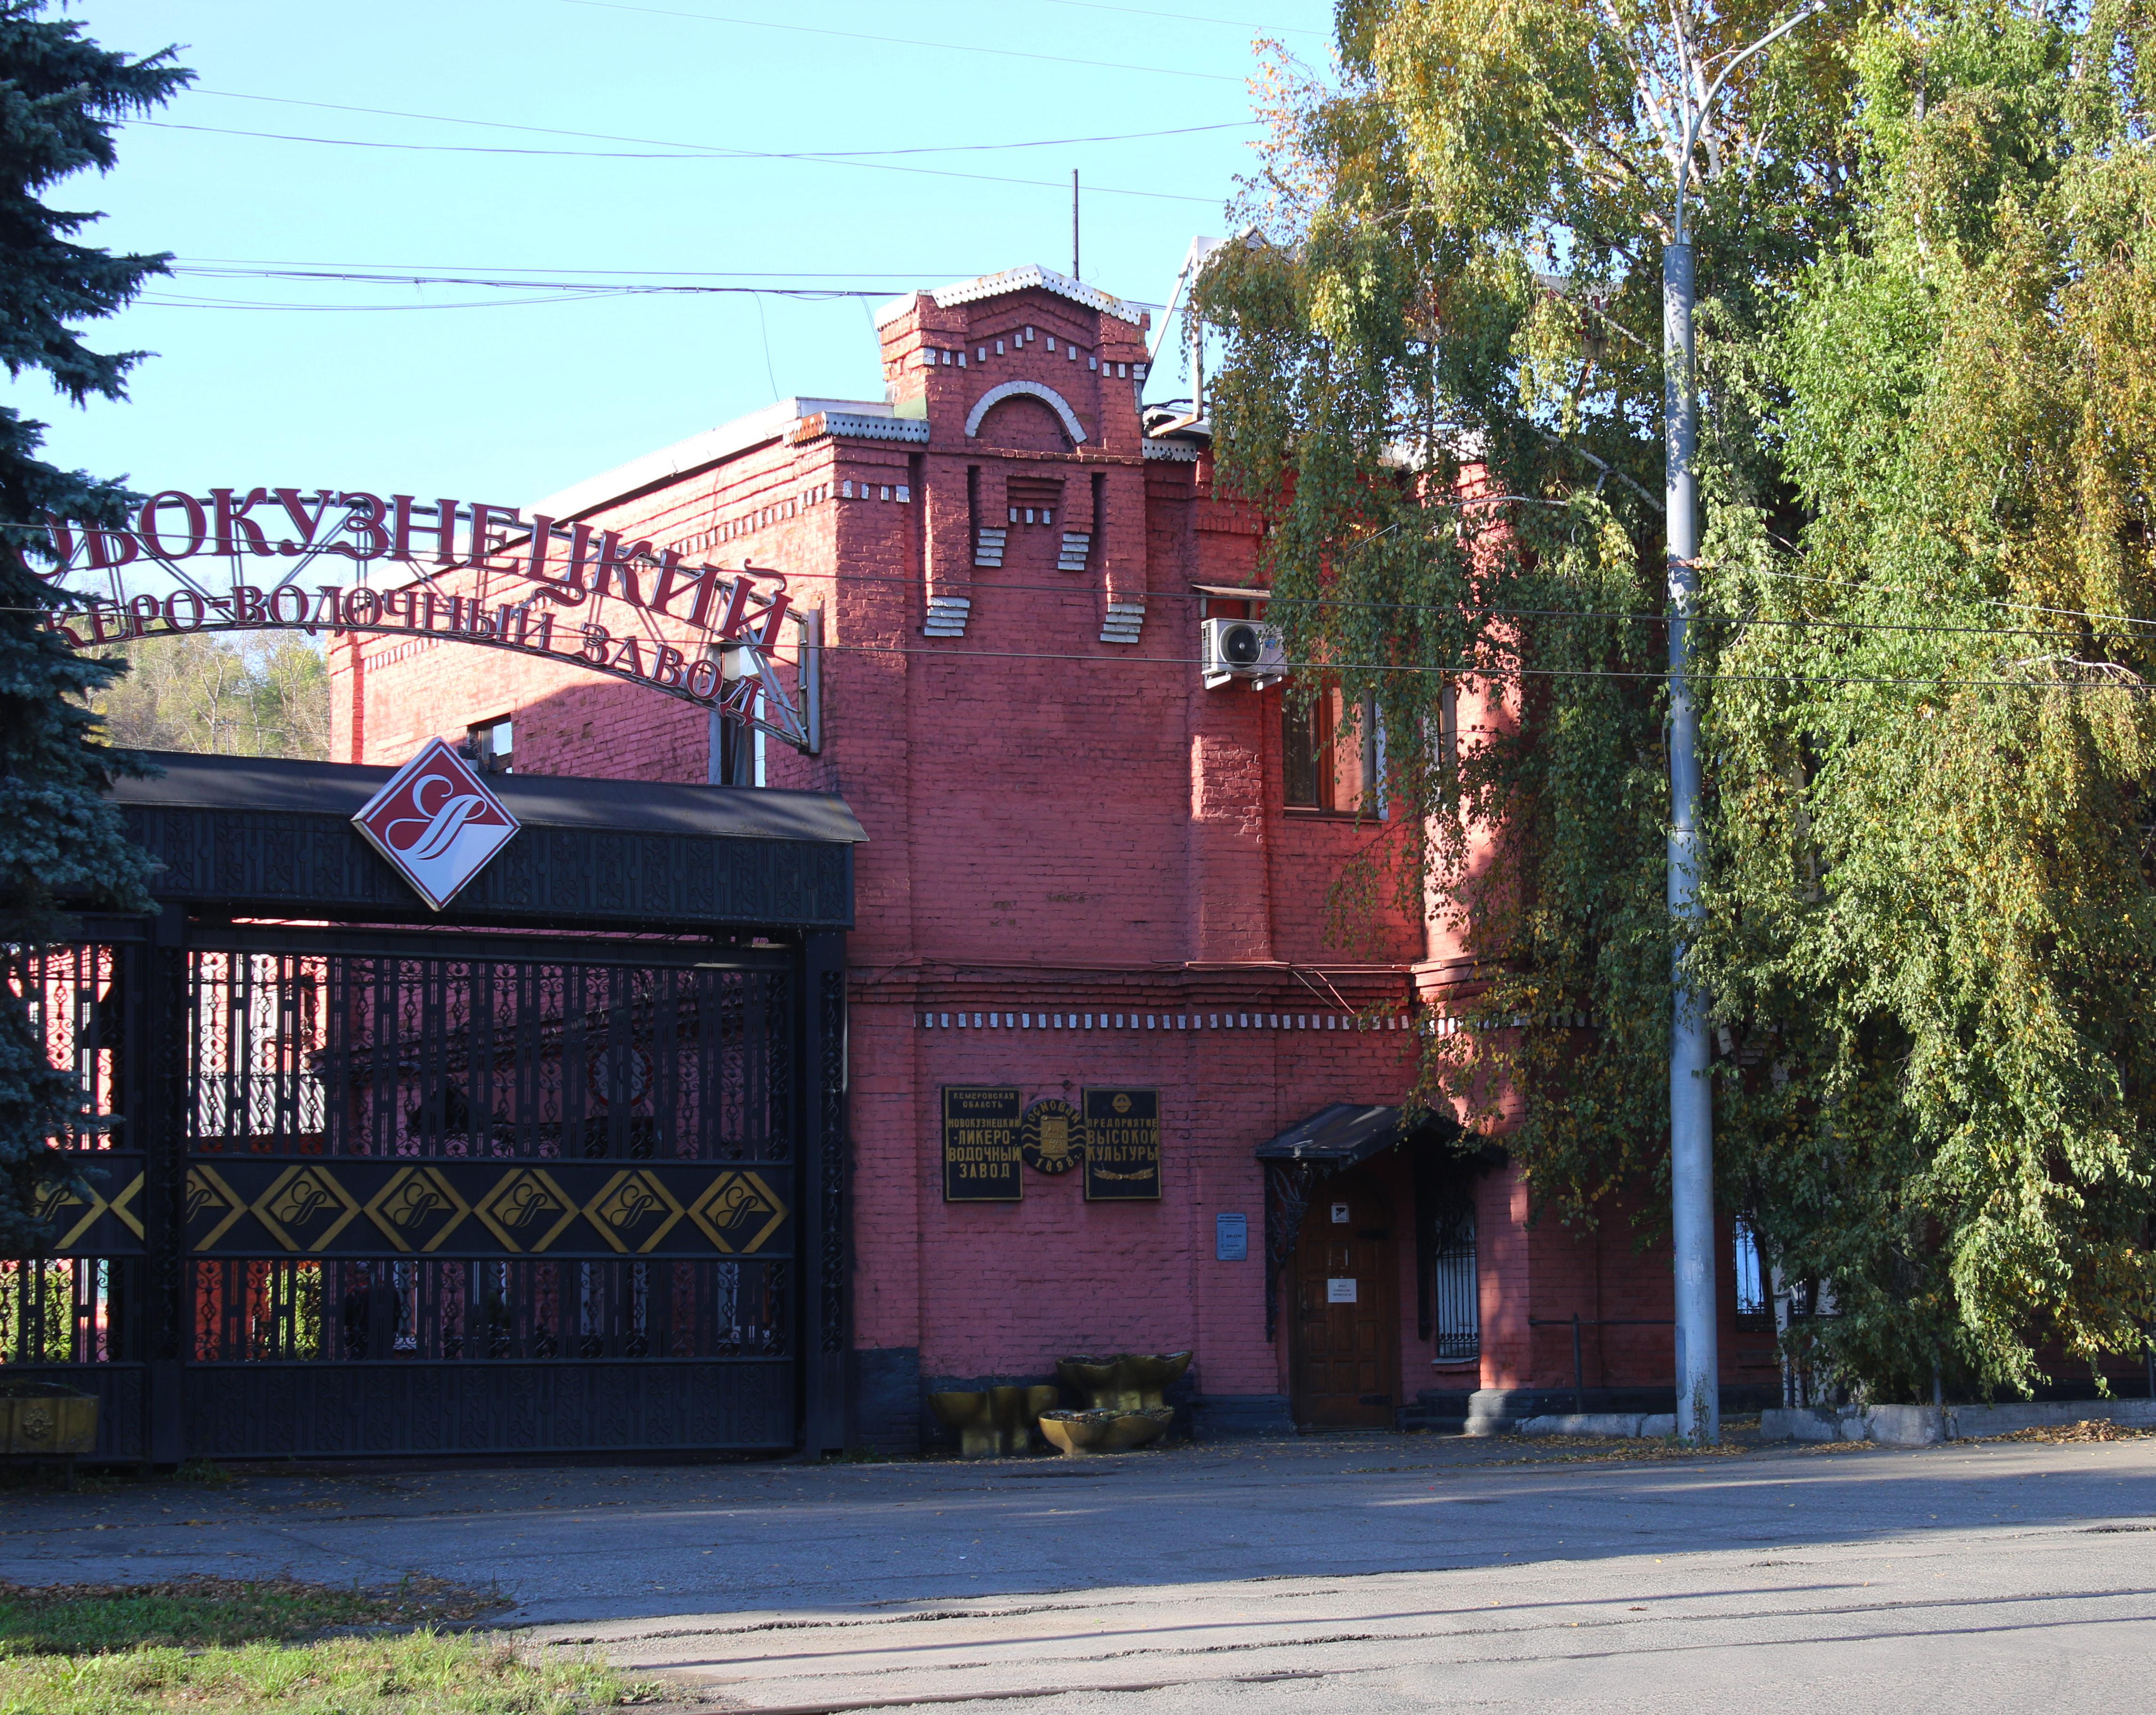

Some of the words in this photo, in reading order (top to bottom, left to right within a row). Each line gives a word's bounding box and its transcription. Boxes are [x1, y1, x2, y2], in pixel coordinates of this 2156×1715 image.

[14, 487, 793, 657] ОВОКУЗНЕЦКИЙ
[572, 622, 763, 727] ЗАВОД
[1027, 1100, 1081, 1123] ОСНОВАН
[948, 1116, 1021, 1128] НОВОКУЗНЕЦКИЙ
[1087, 1118, 1158, 1127] ПРЕДПРИЯТИЕ
[1087, 1128, 1158, 1144] ВЫСОКОЙ
[948, 1144, 1021, 1162] ВОДОЧНЫЙ
[1087, 1146, 1159, 1161] КУЛЬТУРЫ
[959, 1163, 1010, 1178] ЗАВОД
[1035, 1155, 1074, 1172] 1898
